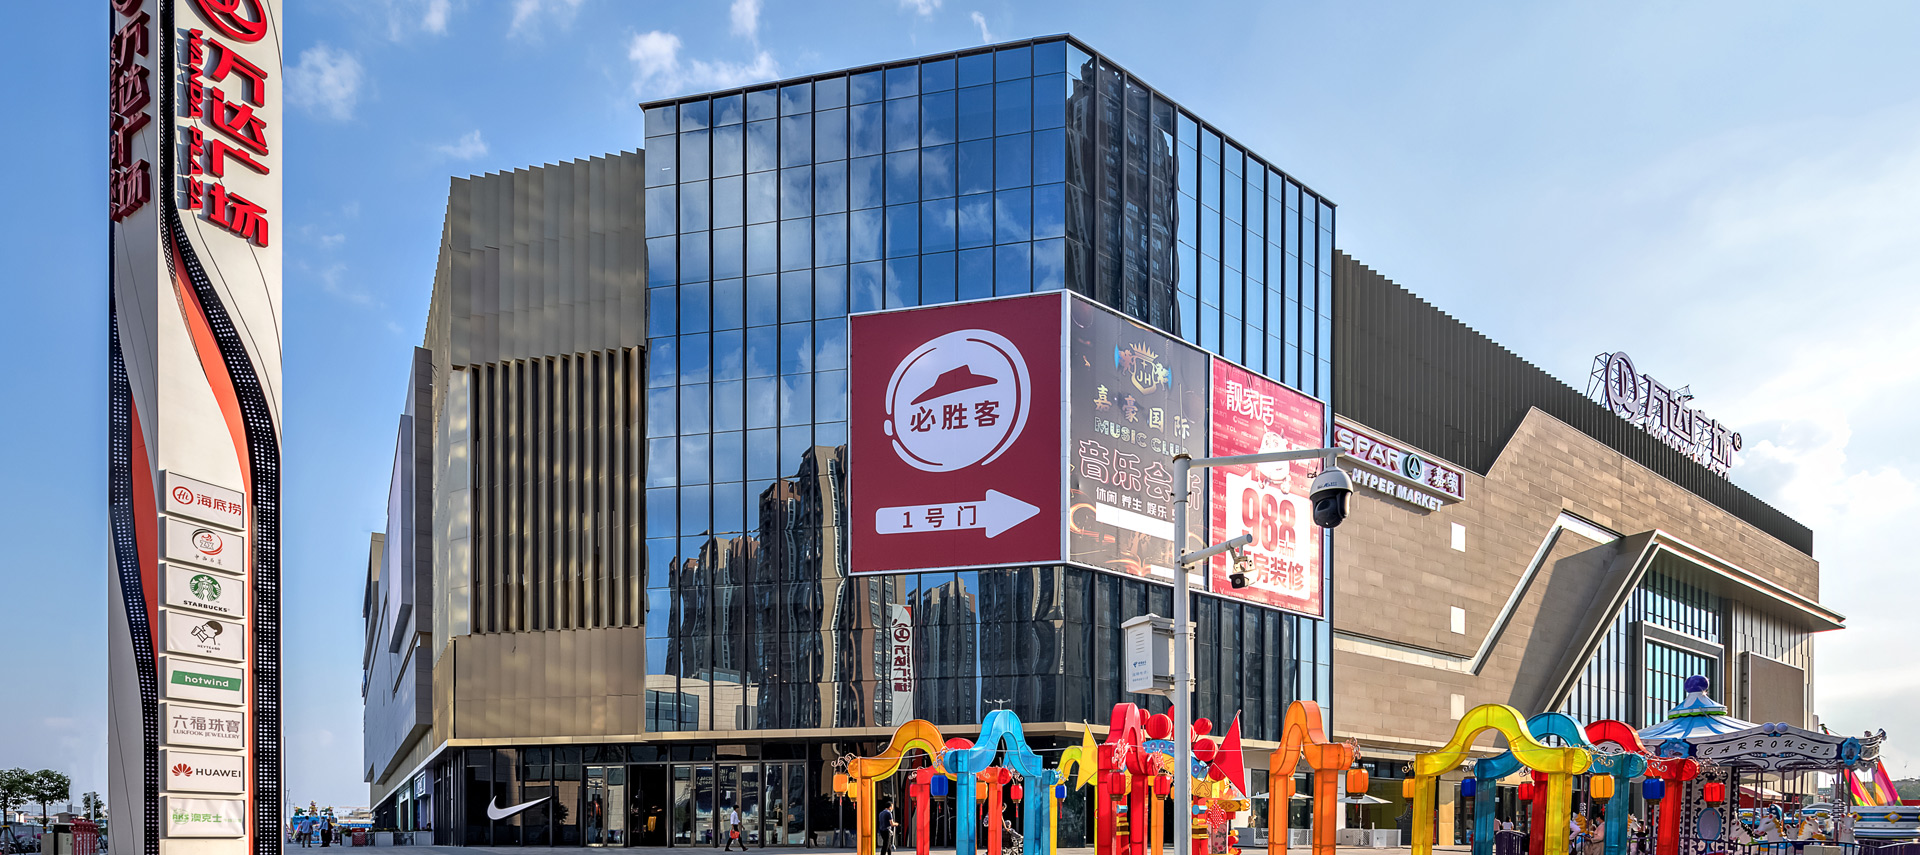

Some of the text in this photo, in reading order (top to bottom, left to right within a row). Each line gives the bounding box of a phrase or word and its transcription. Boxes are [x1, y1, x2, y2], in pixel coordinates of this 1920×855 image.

[118, 11, 150, 216] 万达广场
[190, 28, 203, 211] WANDA PLAZA
[208, 37, 271, 249] 万达广场
[1136, 371, 1153, 386] JH
[909, 400, 1000, 432] 必胜客
[1226, 380, 1274, 426] 靓家居
[1095, 416, 1148, 448] MUSIC
[1643, 373, 1734, 468] 万达广场
[1337, 428, 1400, 471] SPAR
[177, 490, 189, 500] Hi
[197, 493, 242, 516] 海底捞
[1096, 486, 1117, 505] 休闲
[1121, 494, 1142, 512] 养生
[1147, 501, 1167, 519] 娱乐
[1351, 467, 1443, 512] HYPER MARKET
[902, 505, 977, 529] 1号门
[1242, 487, 1296, 552] 988
[1234, 543, 1305, 591] 房装修
[183, 600, 228, 612] STARBUCKS
[184, 675, 229, 687] hotwind
[172, 715, 240, 733] 六福珠寶
[1703, 739, 1830, 756] CARROUSEL
[195, 768, 241, 778] HUAWEI
